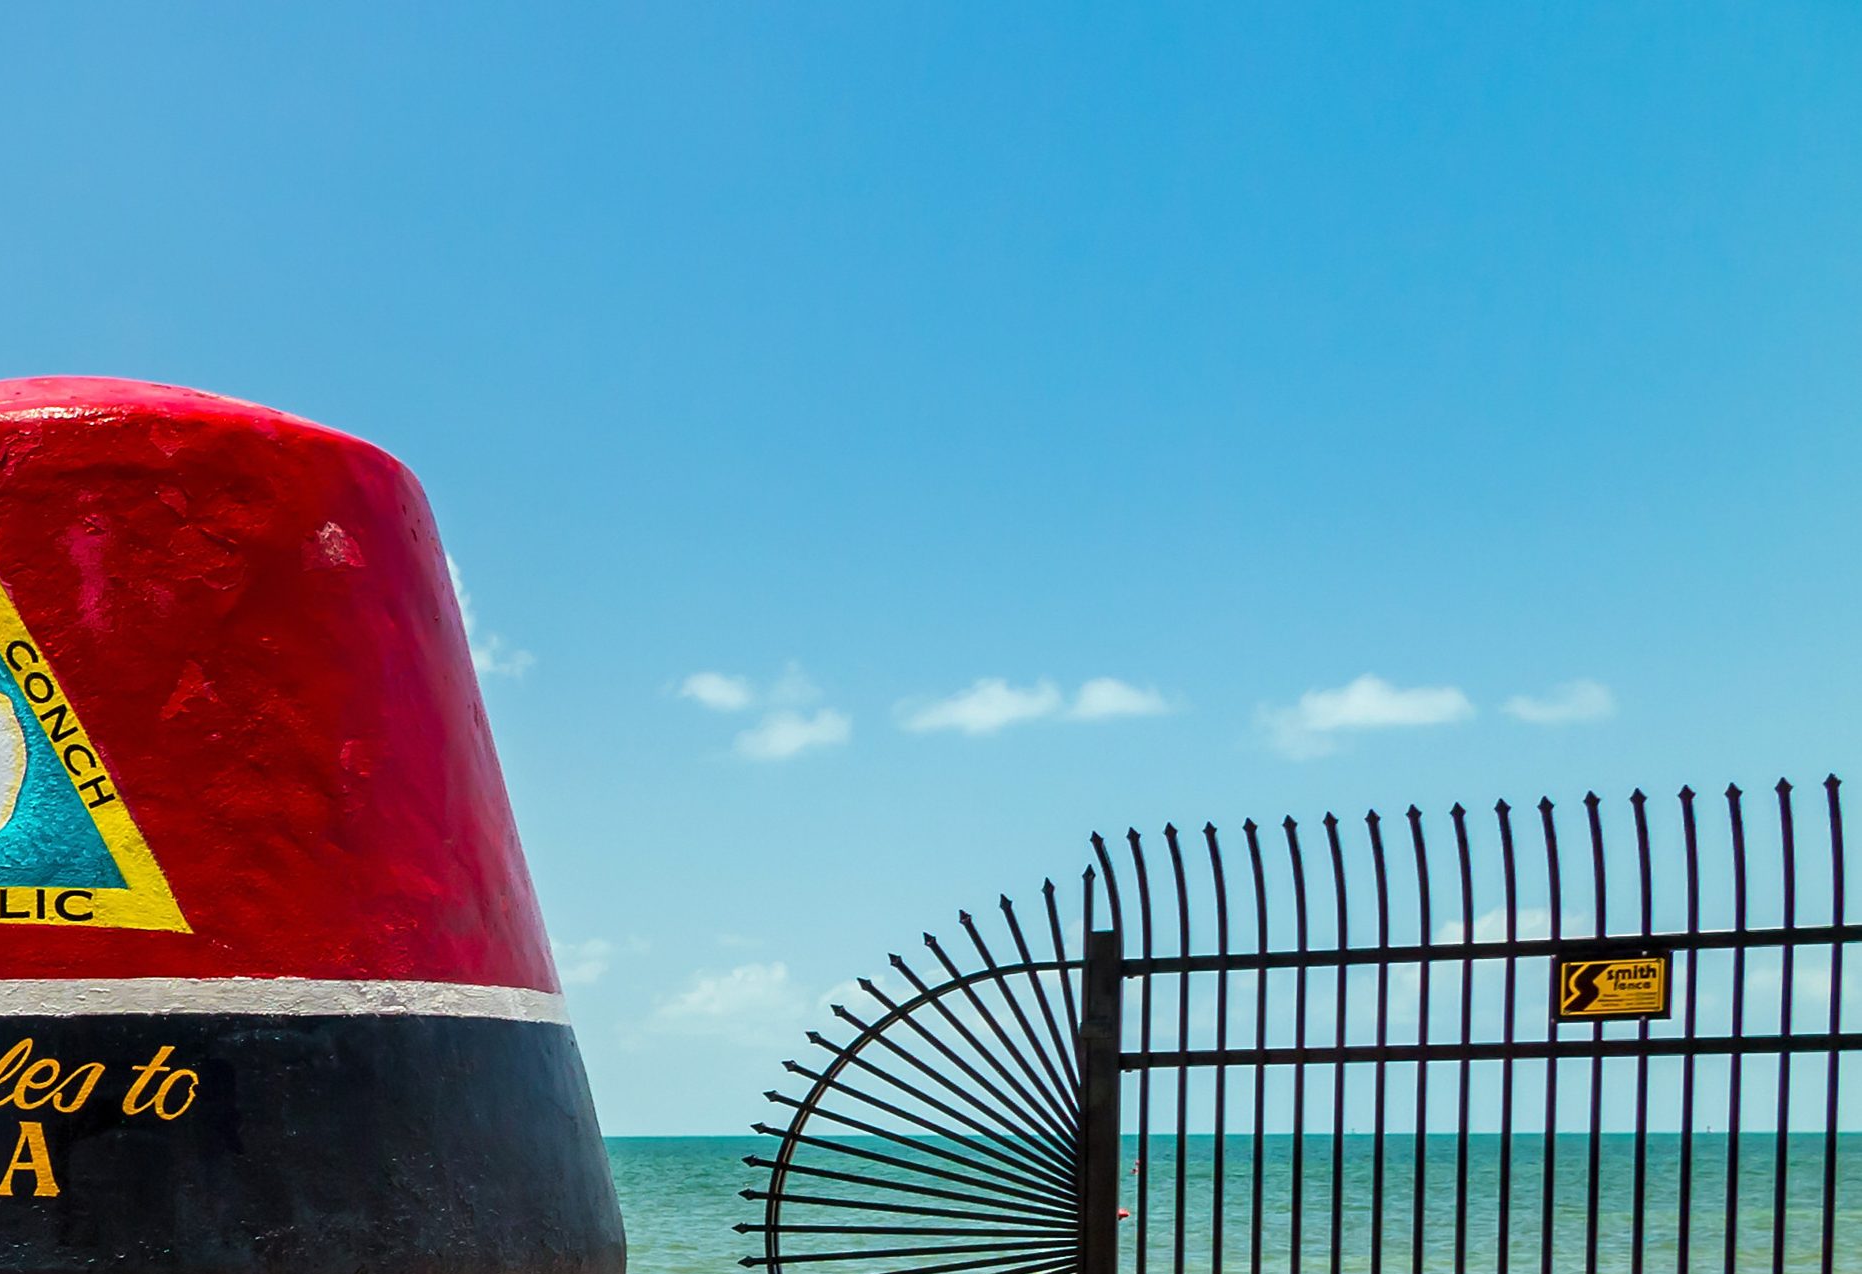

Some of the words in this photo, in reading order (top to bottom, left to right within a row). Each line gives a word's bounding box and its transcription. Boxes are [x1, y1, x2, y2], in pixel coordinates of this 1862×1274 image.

[6, 640, 116, 809] CONCH
[1607, 966, 1656, 980] smith
[122, 1046, 199, 1121] to
